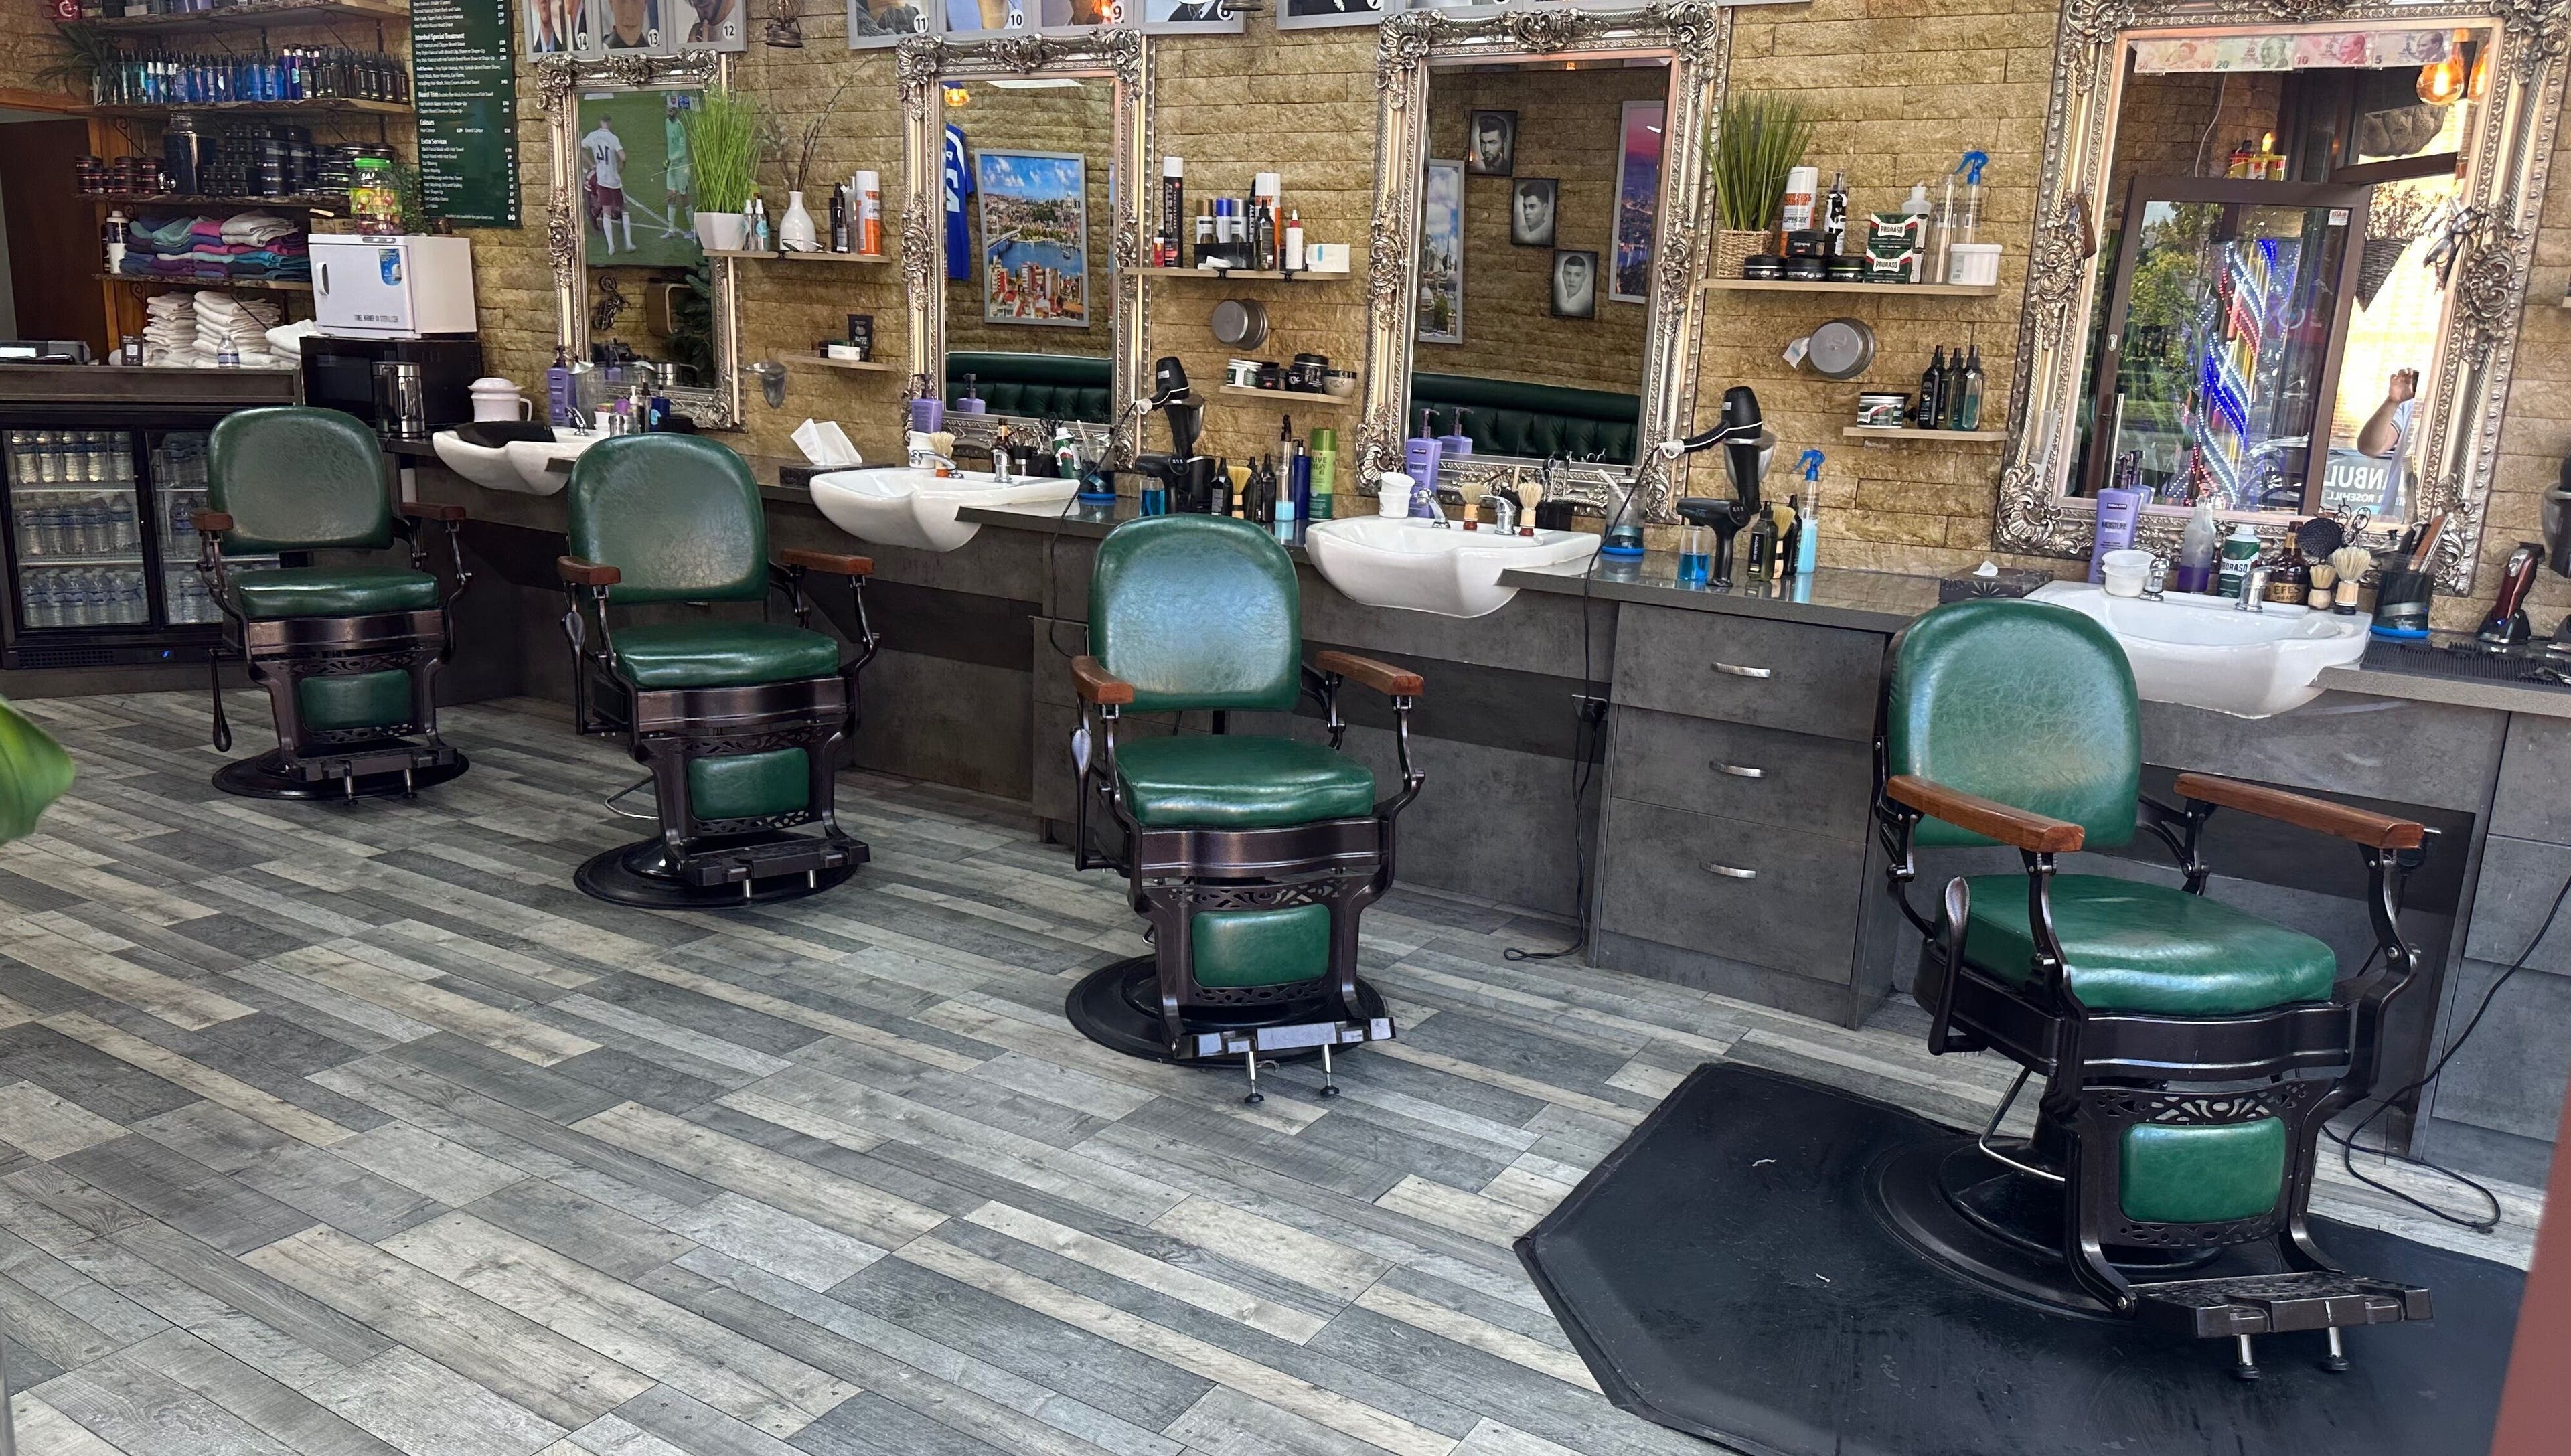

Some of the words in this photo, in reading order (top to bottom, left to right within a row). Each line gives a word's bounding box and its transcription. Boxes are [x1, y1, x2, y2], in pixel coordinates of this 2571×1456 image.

[1113, 5, 1122, 19] 9
[915, 18, 926, 30] 11
[1010, 14, 1022, 25] 10
[724, 25, 734, 36] 12
[578, 35, 587, 48] 14
[649, 33, 657, 45] 13
[2215, 61, 2228, 69] 20
[2296, 56, 2309, 66] 10
[2375, 55, 2382, 64] 5
[2102, 521, 2127, 530] MOISTURE
[2274, 586, 2301, 594] EFES
